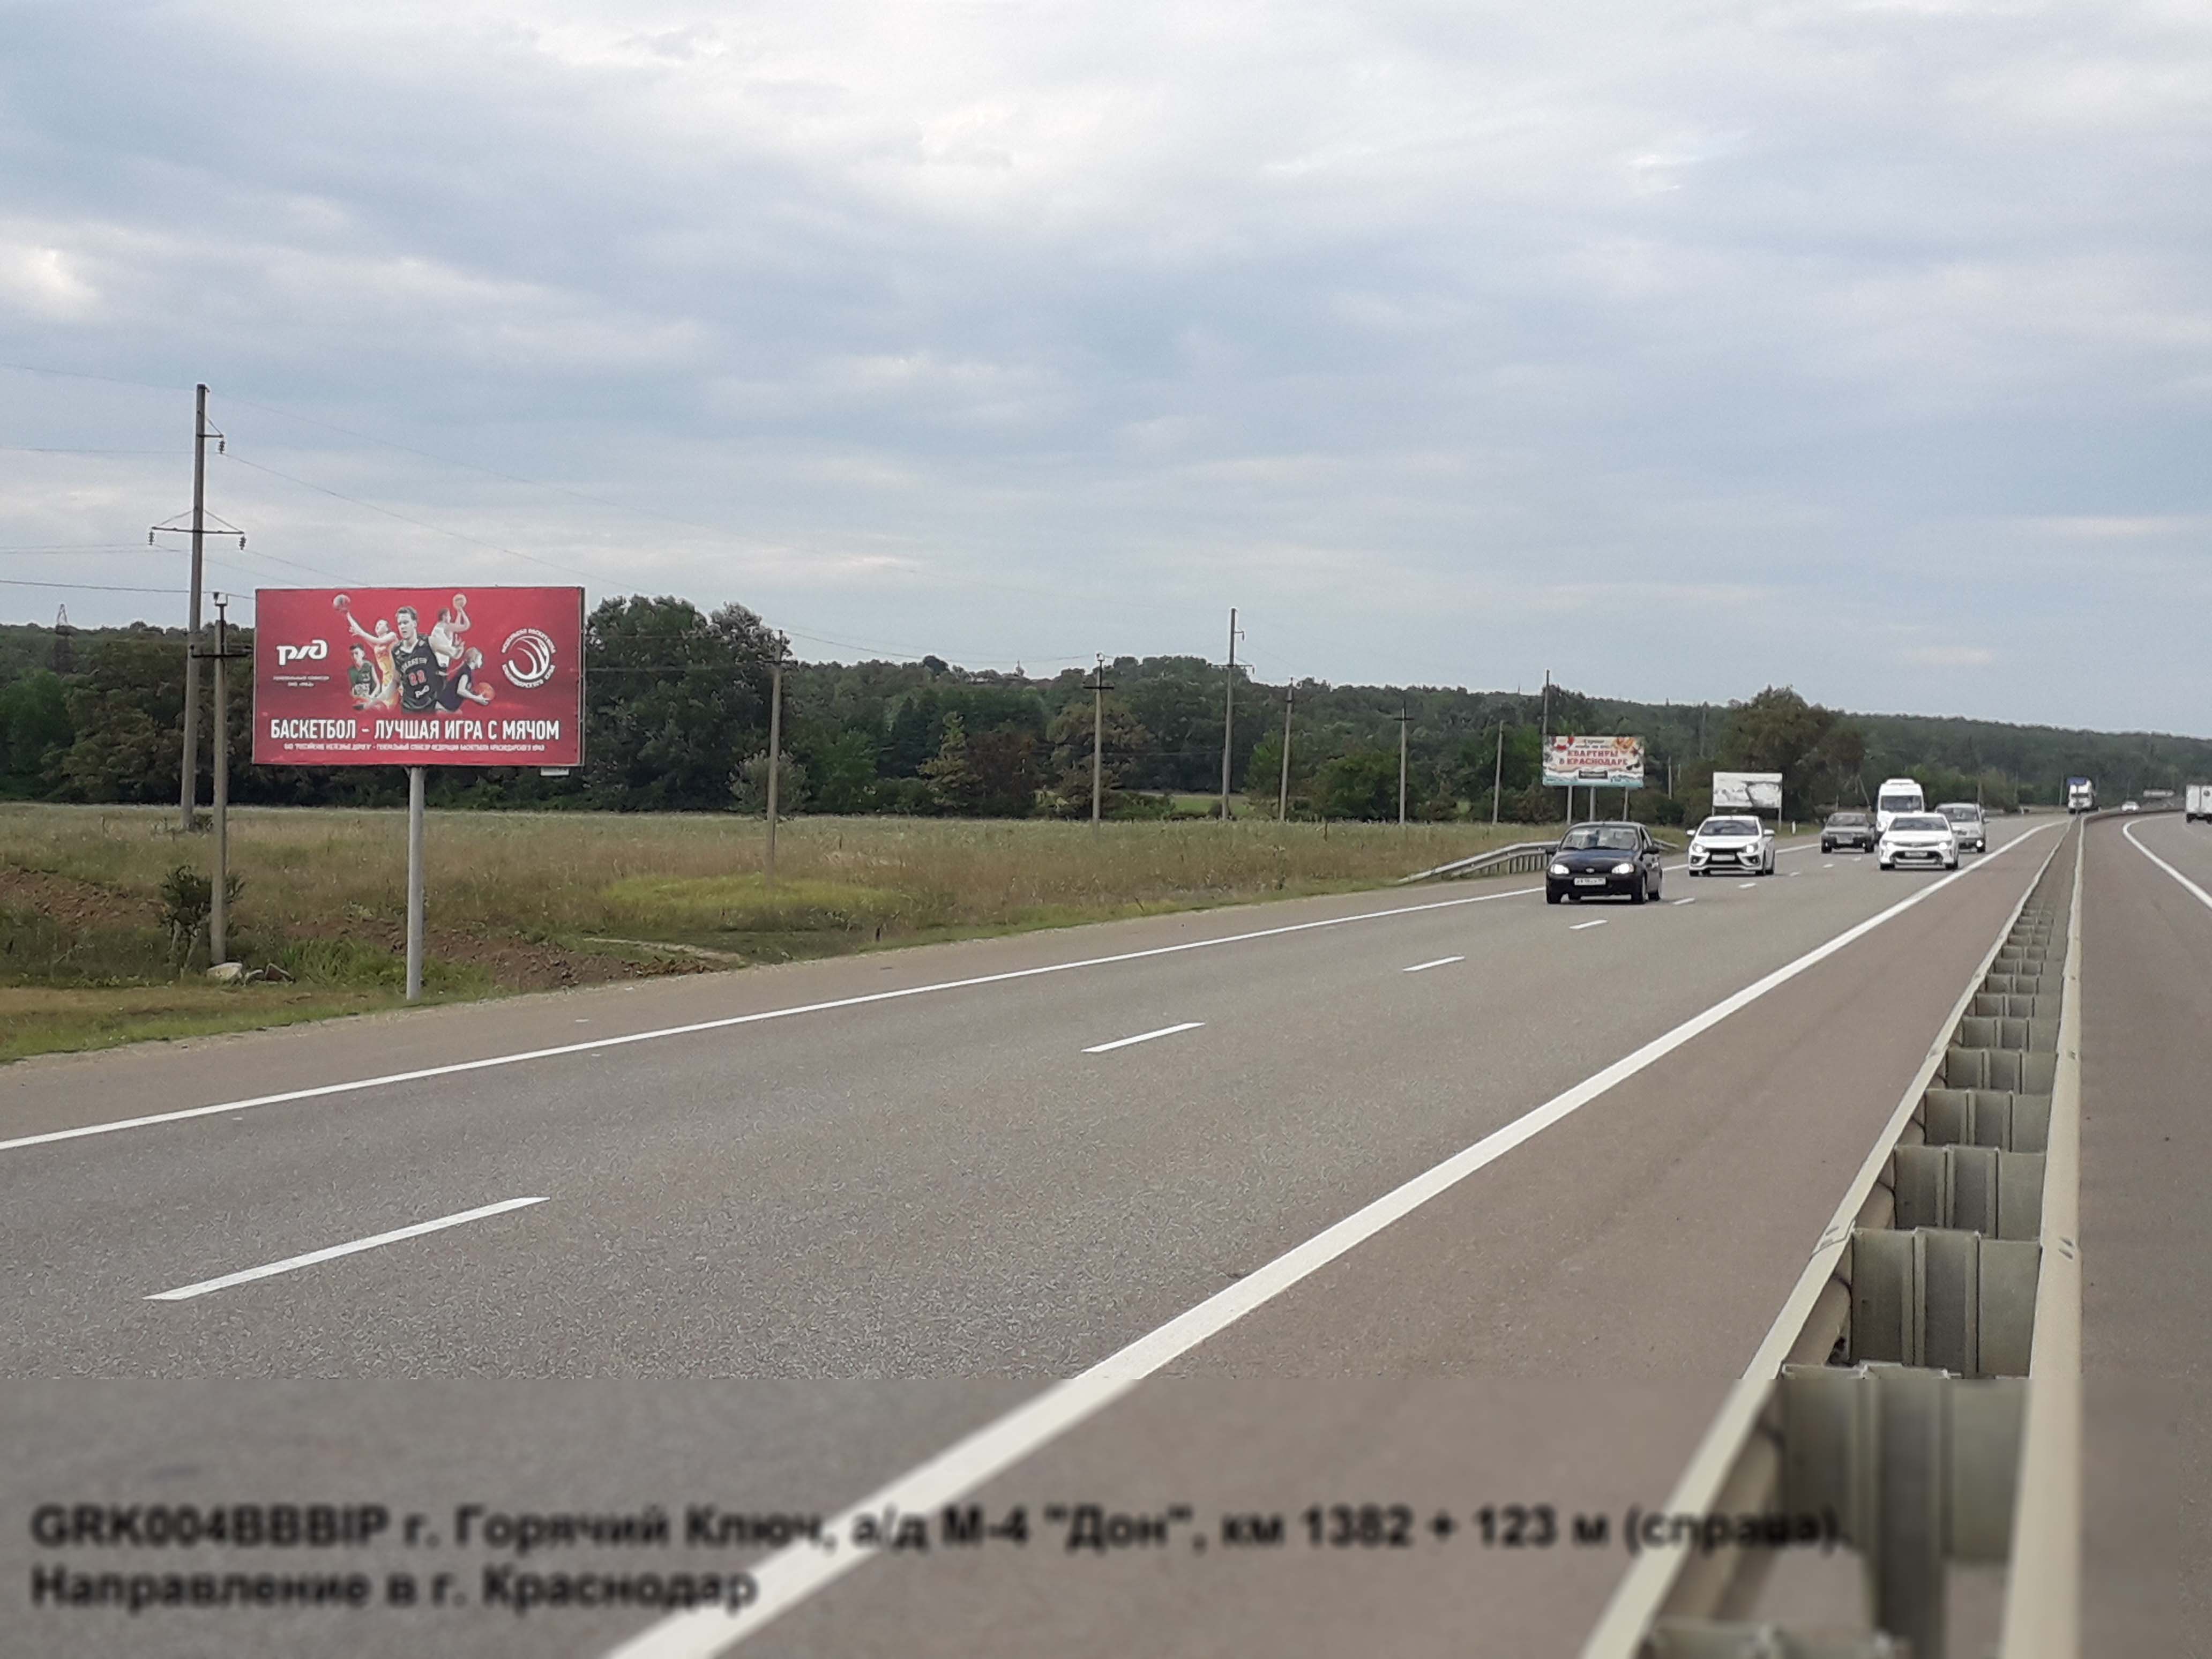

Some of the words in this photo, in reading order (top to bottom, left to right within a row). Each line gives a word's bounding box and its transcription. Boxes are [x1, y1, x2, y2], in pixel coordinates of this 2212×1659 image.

[271, 719, 356, 739] БАСКЕТБОЛ
[374, 719, 439, 739] ЛУЧШАЯ
[444, 720, 483, 740] ИГРА
[488, 720, 498, 740] С
[502, 720, 559, 740] МЯЧОМ
